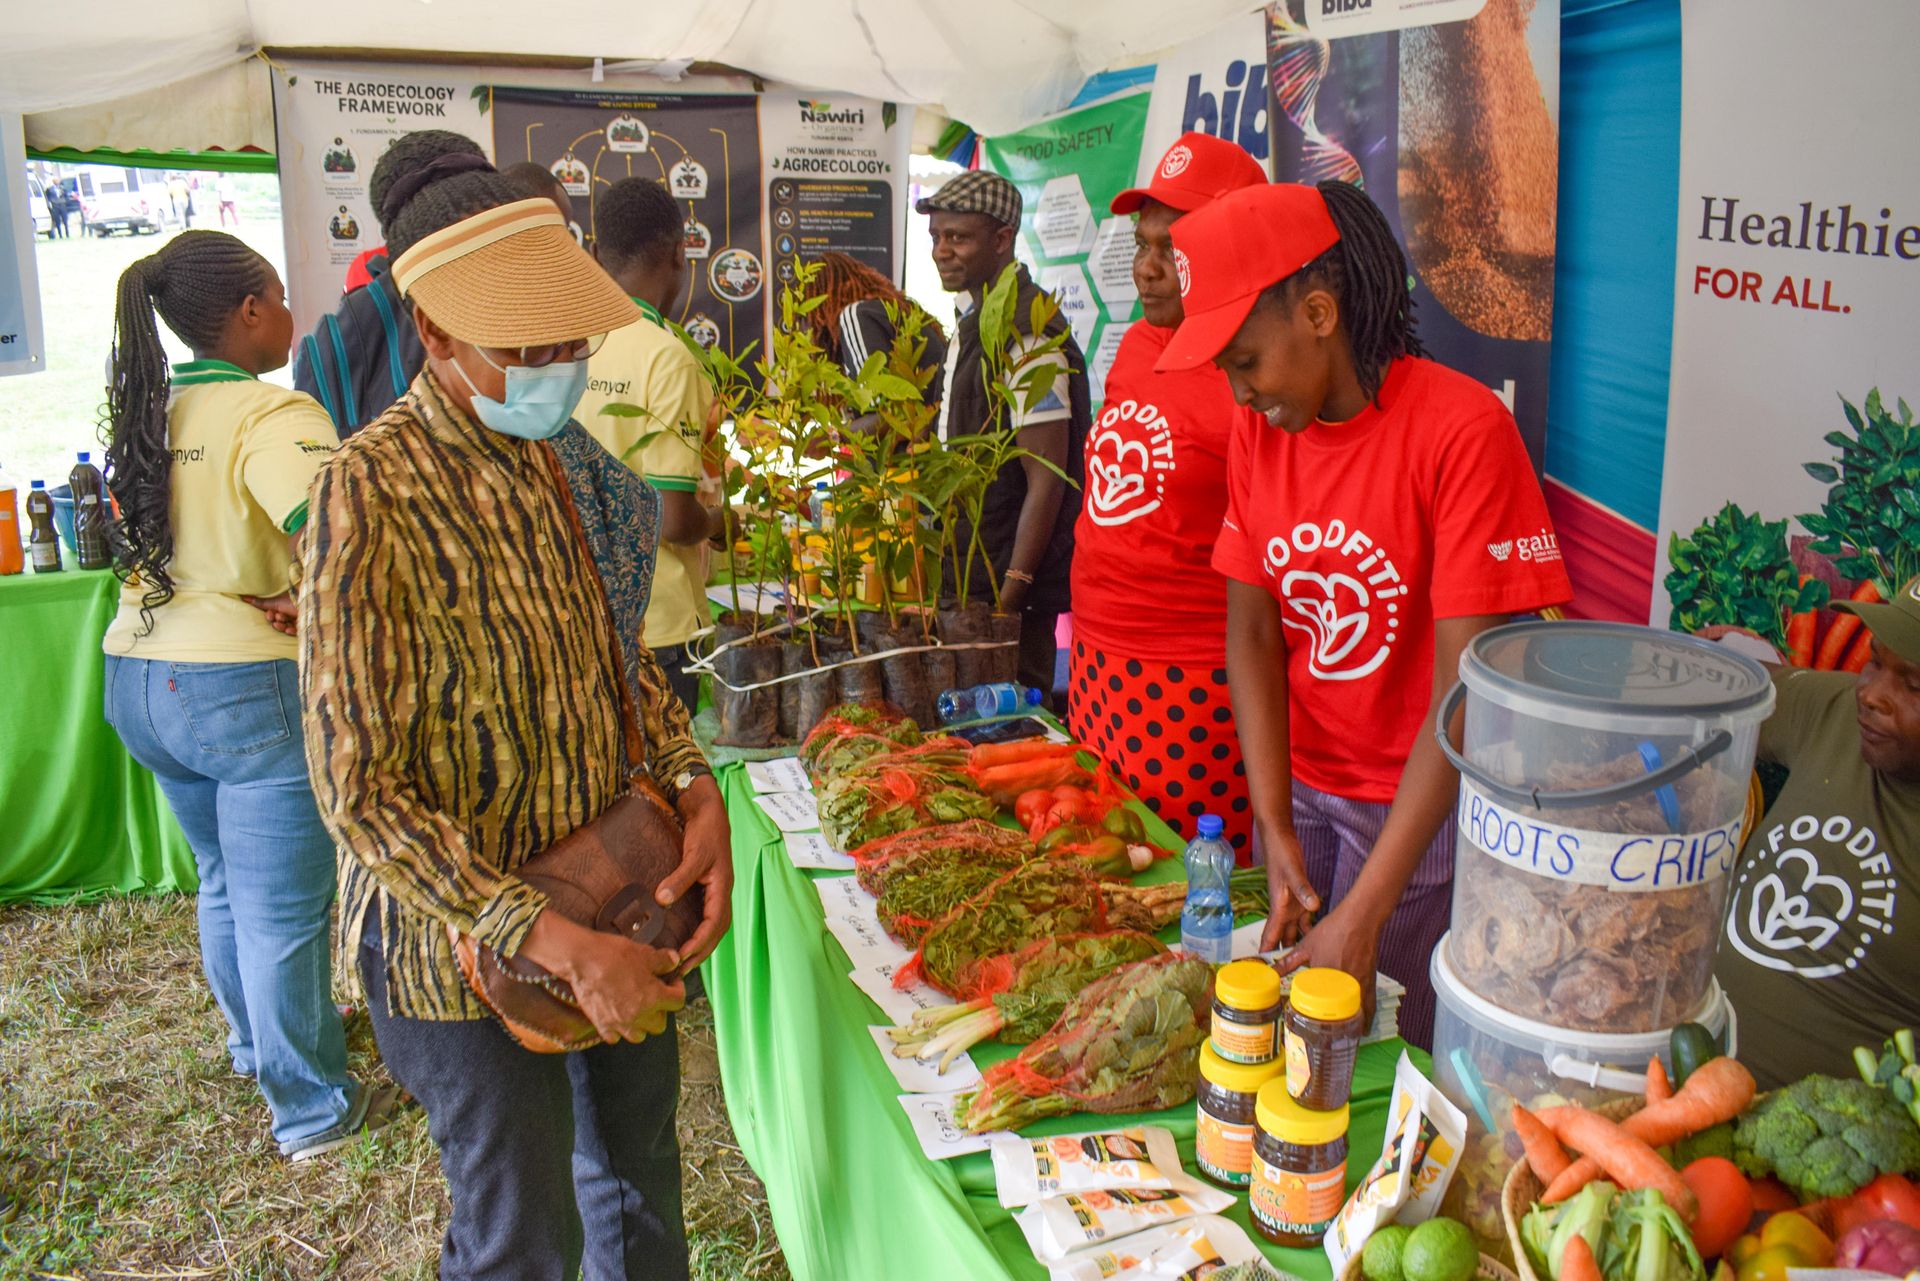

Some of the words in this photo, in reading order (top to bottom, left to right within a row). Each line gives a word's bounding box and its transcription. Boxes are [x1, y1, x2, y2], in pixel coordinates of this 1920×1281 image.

[314, 80, 342, 95] THE
[346, 82, 456, 101] AGROECOLOGY
[338, 97, 446, 117] FRAMEWORK
[801, 108, 865, 125] Nawiri
[1181, 59, 1269, 160] bib
[1057, 122, 1115, 157] SAFETY
[786, 147, 807, 155] HOW
[808, 147, 836, 156] NAWIRI
[836, 148, 878, 158] PRACTICES
[782, 157, 885, 175] AGROECOLOGY
[1697, 195, 1920, 261] Healthie
[1694, 265, 1764, 304] FOR
[1771, 275, 1852, 314] ALL.
[0, 333, 18, 344] er
[171, 445, 205, 465] enya!
[1471, 795, 1580, 876] ROOTS
[1610, 822, 1740, 886] CRIPS
[1197, 1152, 1231, 1182] TURAL
[1259, 1210, 1316, 1235] NATURAL
